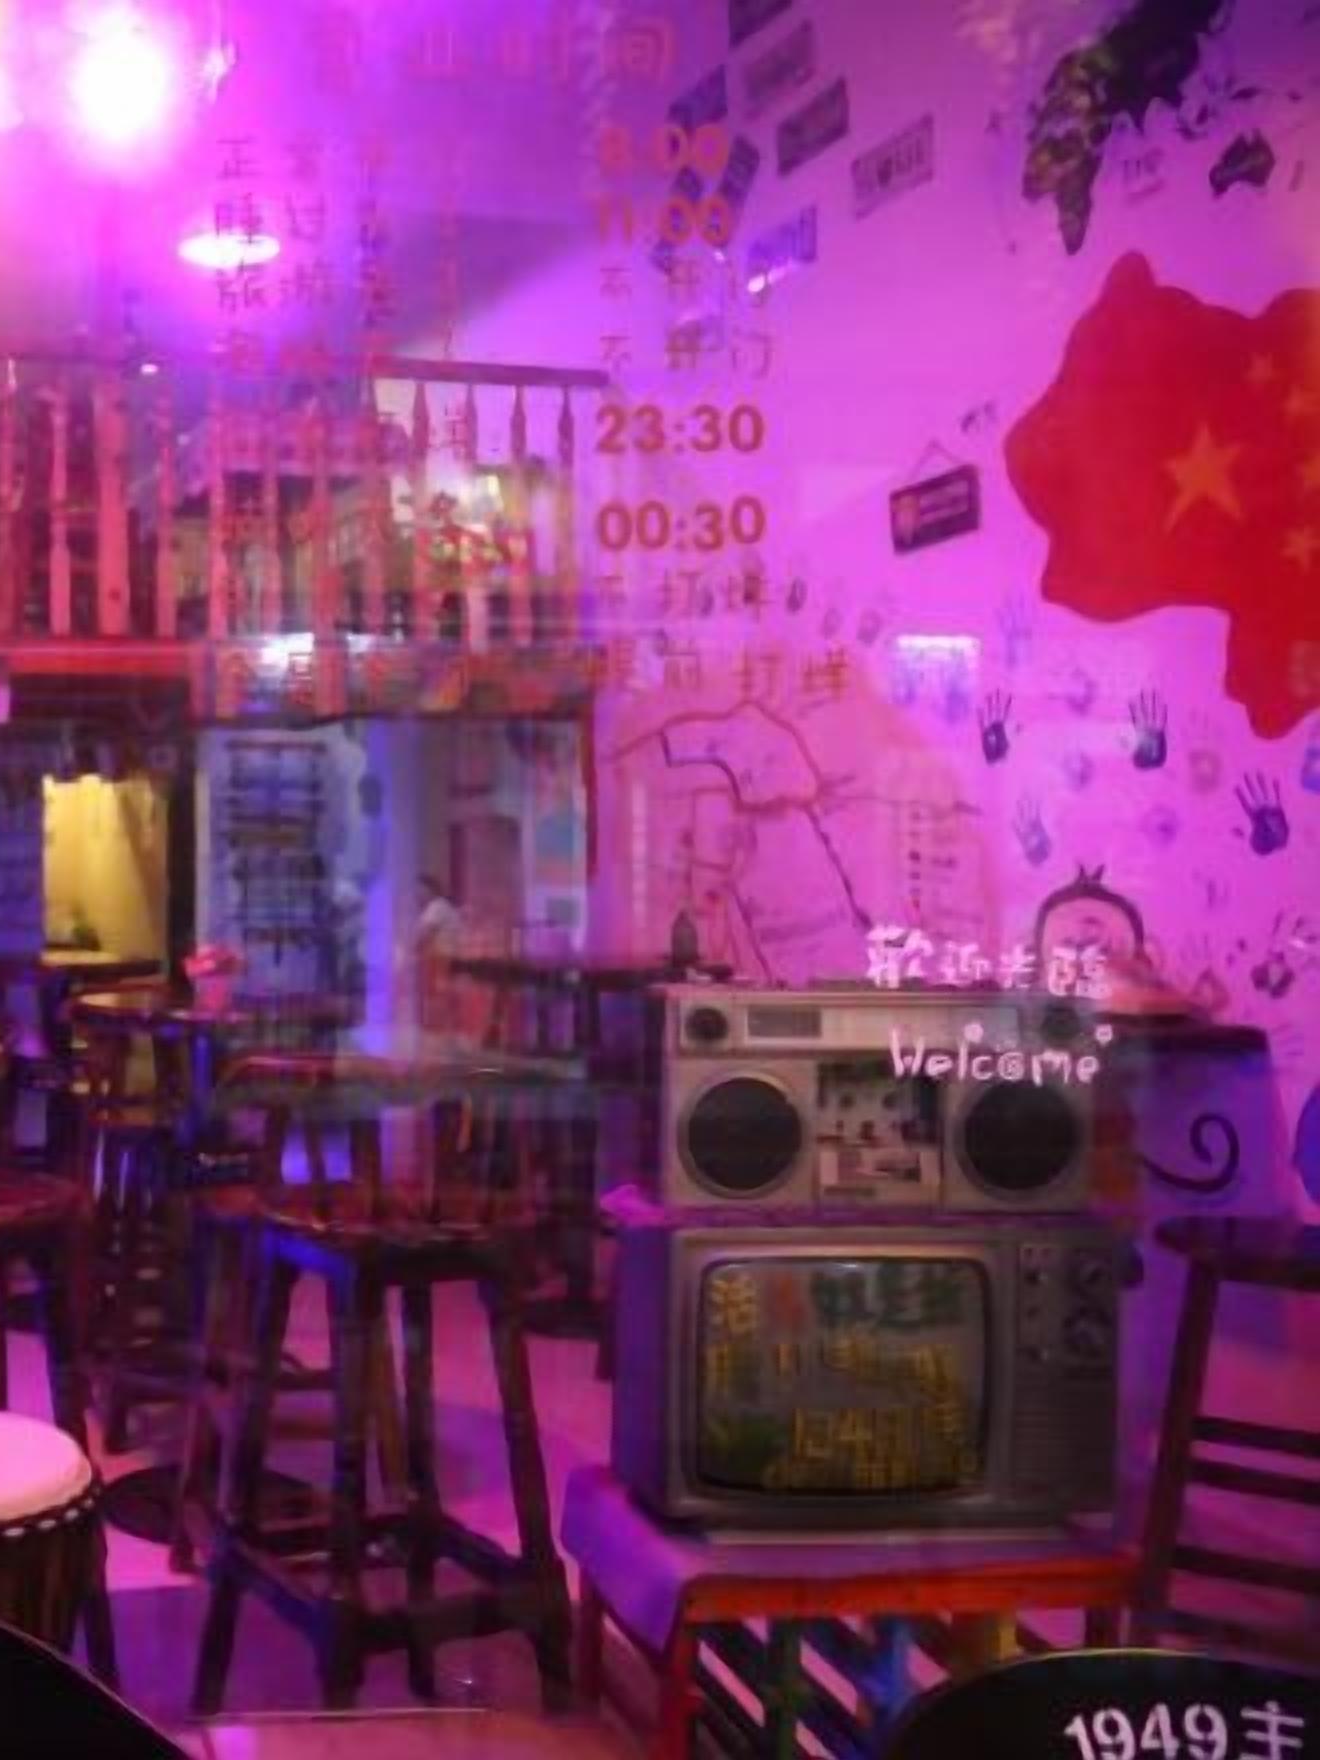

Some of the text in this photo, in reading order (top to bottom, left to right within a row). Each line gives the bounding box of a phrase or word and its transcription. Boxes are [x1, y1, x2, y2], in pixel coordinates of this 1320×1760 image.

[595, 403, 765, 455] 23:30
[597, 495, 767, 552] 00:30
[888, 1026, 1102, 1088] Welcome
